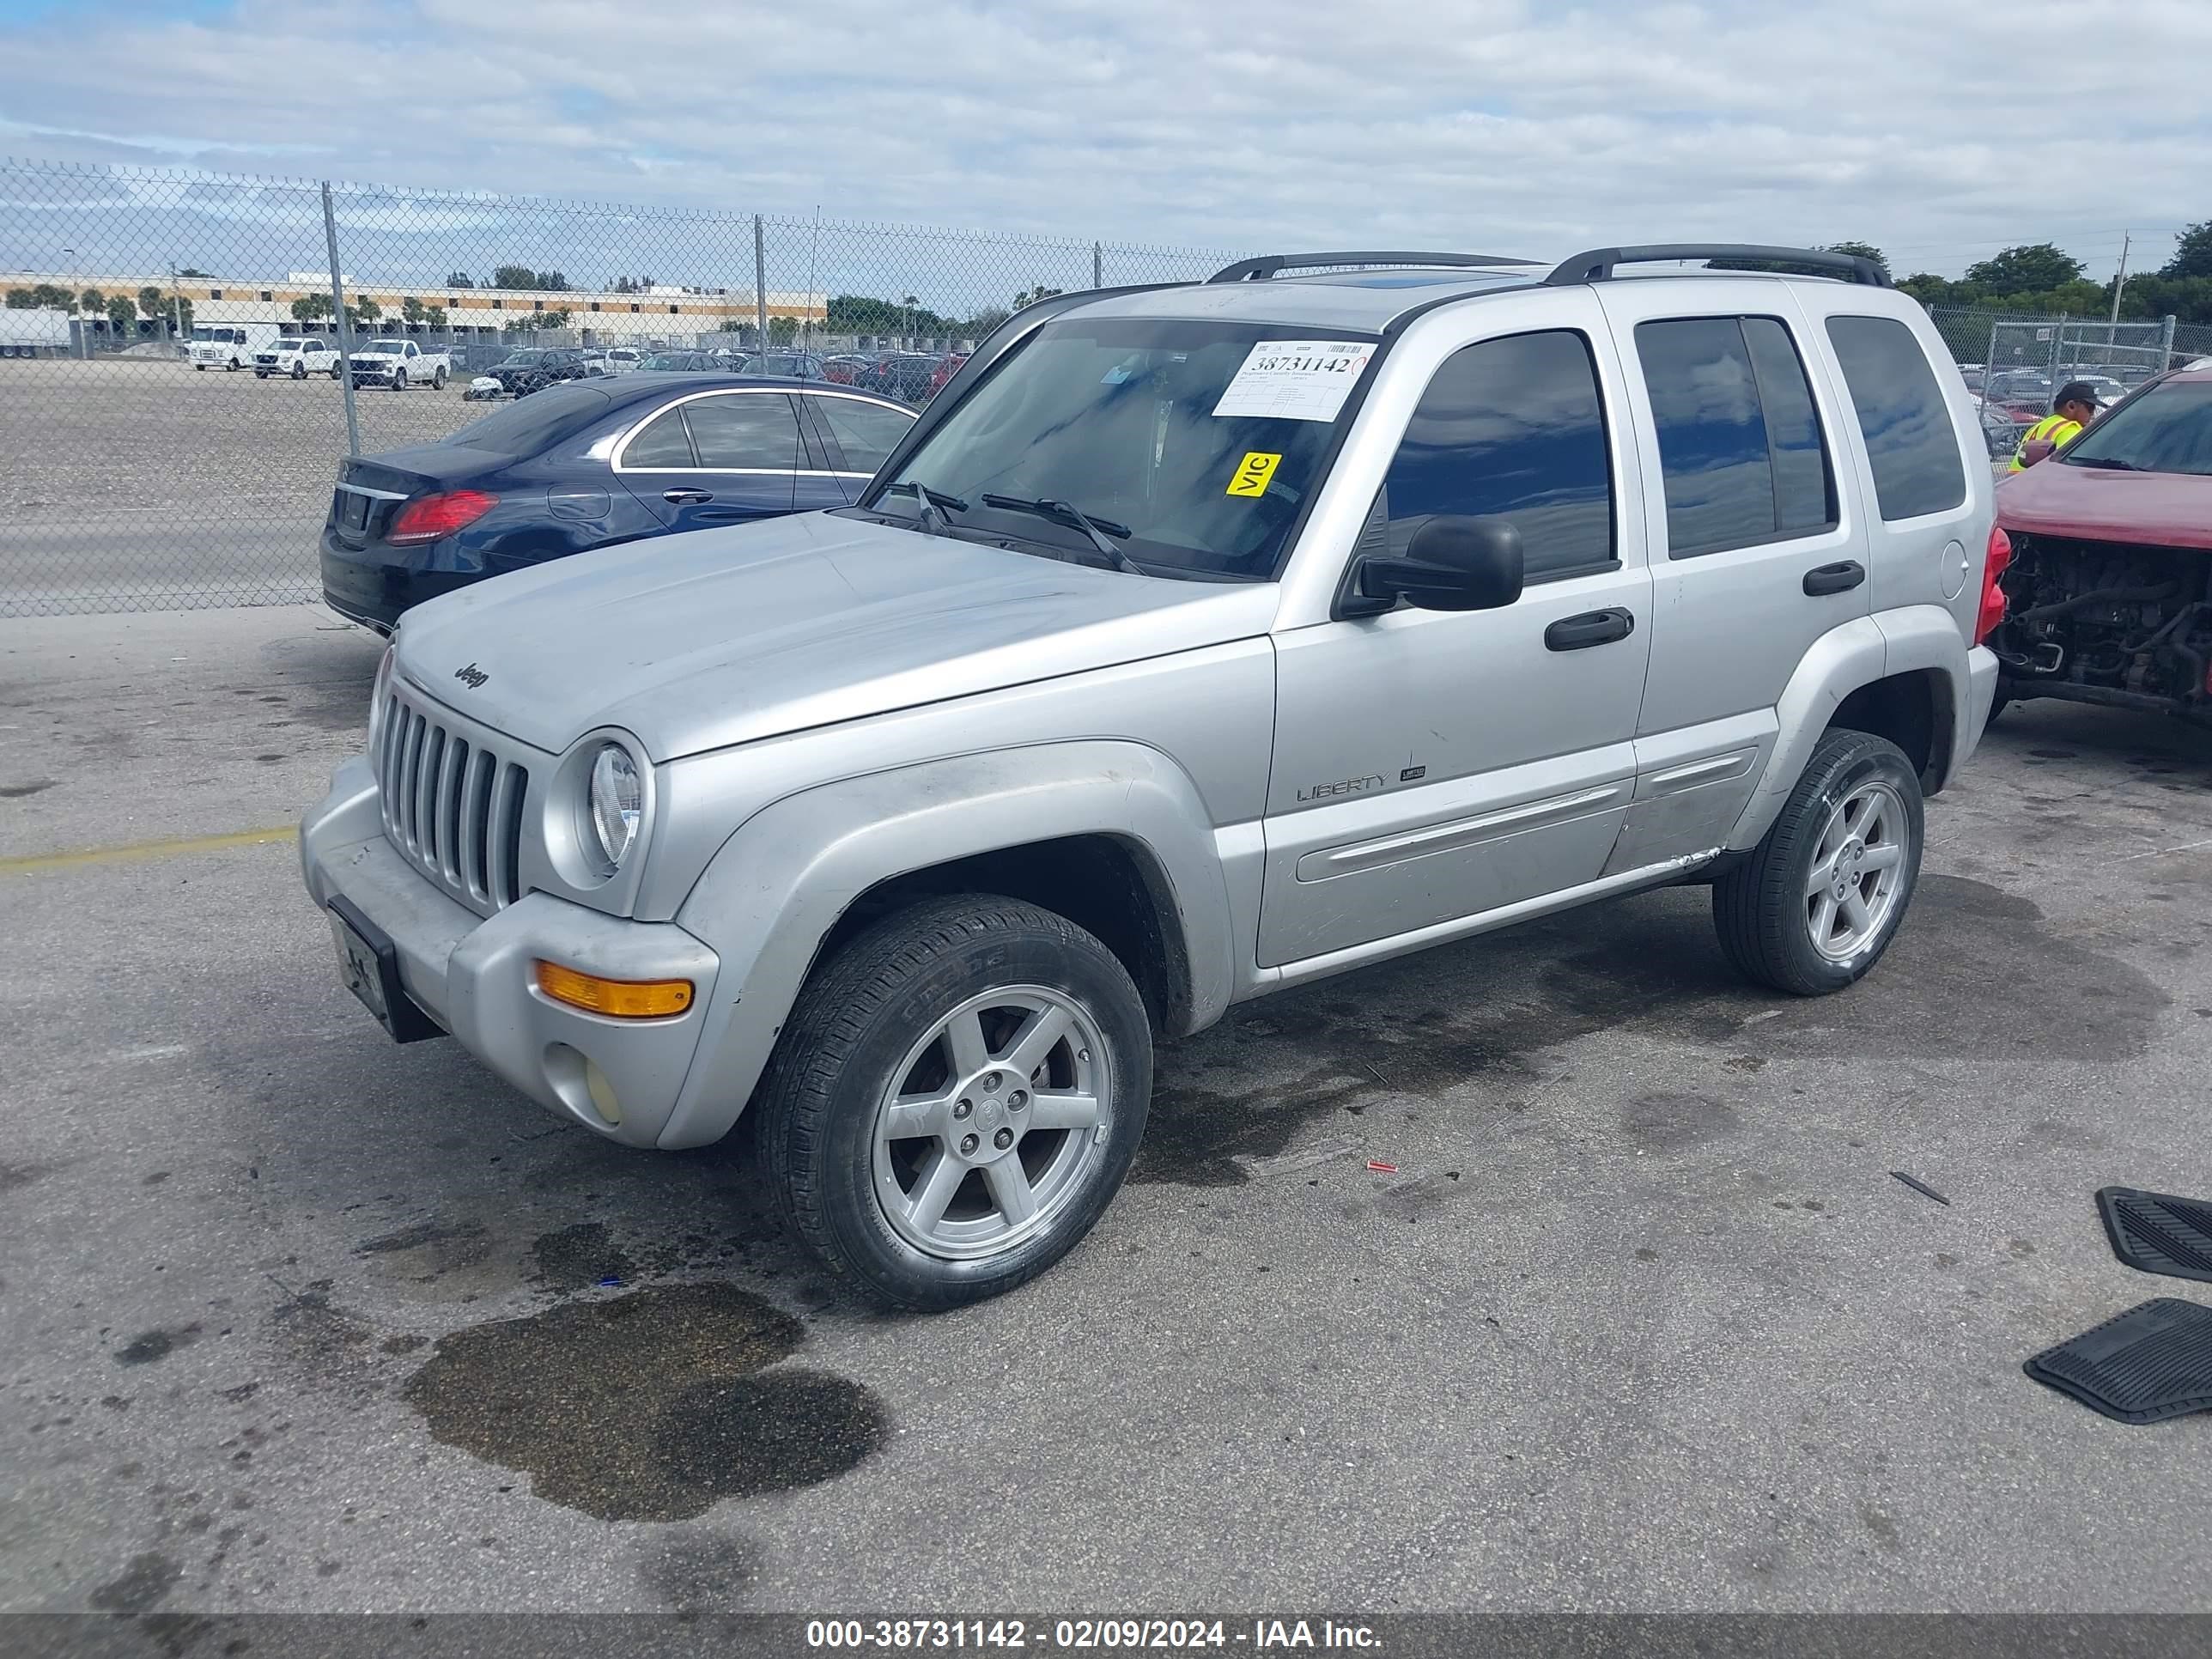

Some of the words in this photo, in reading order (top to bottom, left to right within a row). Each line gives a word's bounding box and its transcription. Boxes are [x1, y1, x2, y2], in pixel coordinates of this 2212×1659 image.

[1251, 356, 1351, 373] 38731142
[1237, 457, 1270, 490] VIC
[454, 662, 489, 690] Jeep
[1297, 771, 1390, 802] LIBERTY
